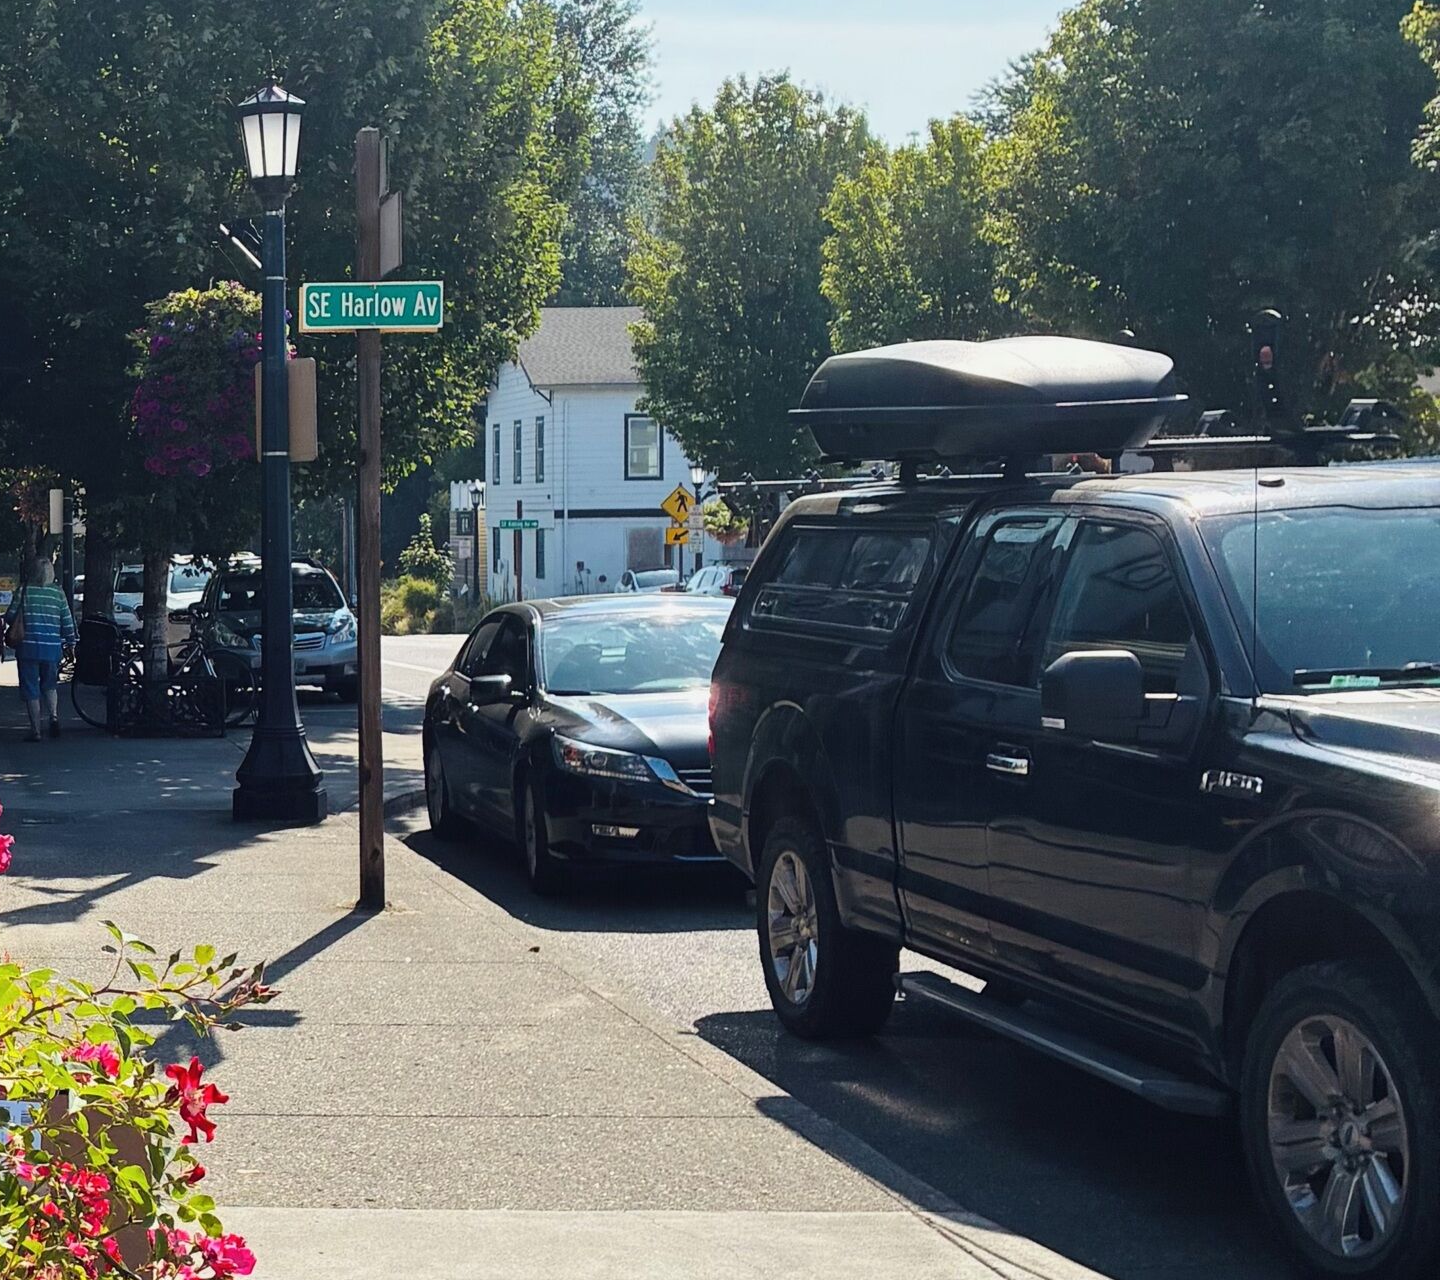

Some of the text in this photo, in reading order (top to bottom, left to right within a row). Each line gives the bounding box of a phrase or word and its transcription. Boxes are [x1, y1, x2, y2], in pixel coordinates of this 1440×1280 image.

[308, 290, 438, 318] SE Harlow Av
